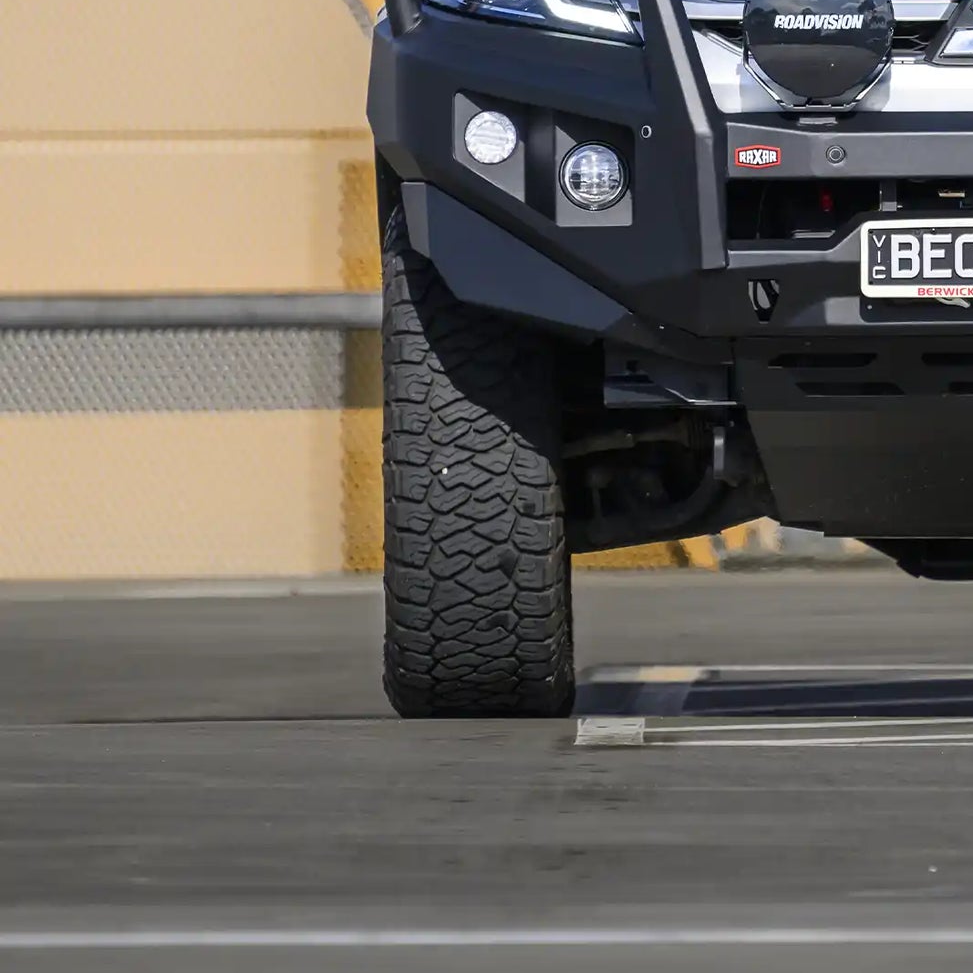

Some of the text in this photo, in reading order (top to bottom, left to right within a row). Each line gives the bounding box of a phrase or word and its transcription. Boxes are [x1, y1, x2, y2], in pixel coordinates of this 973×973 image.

[774, 14, 864, 30] ROADVISION
[739, 149, 777, 165] RAXAR
[873, 235, 886, 279] VIC
